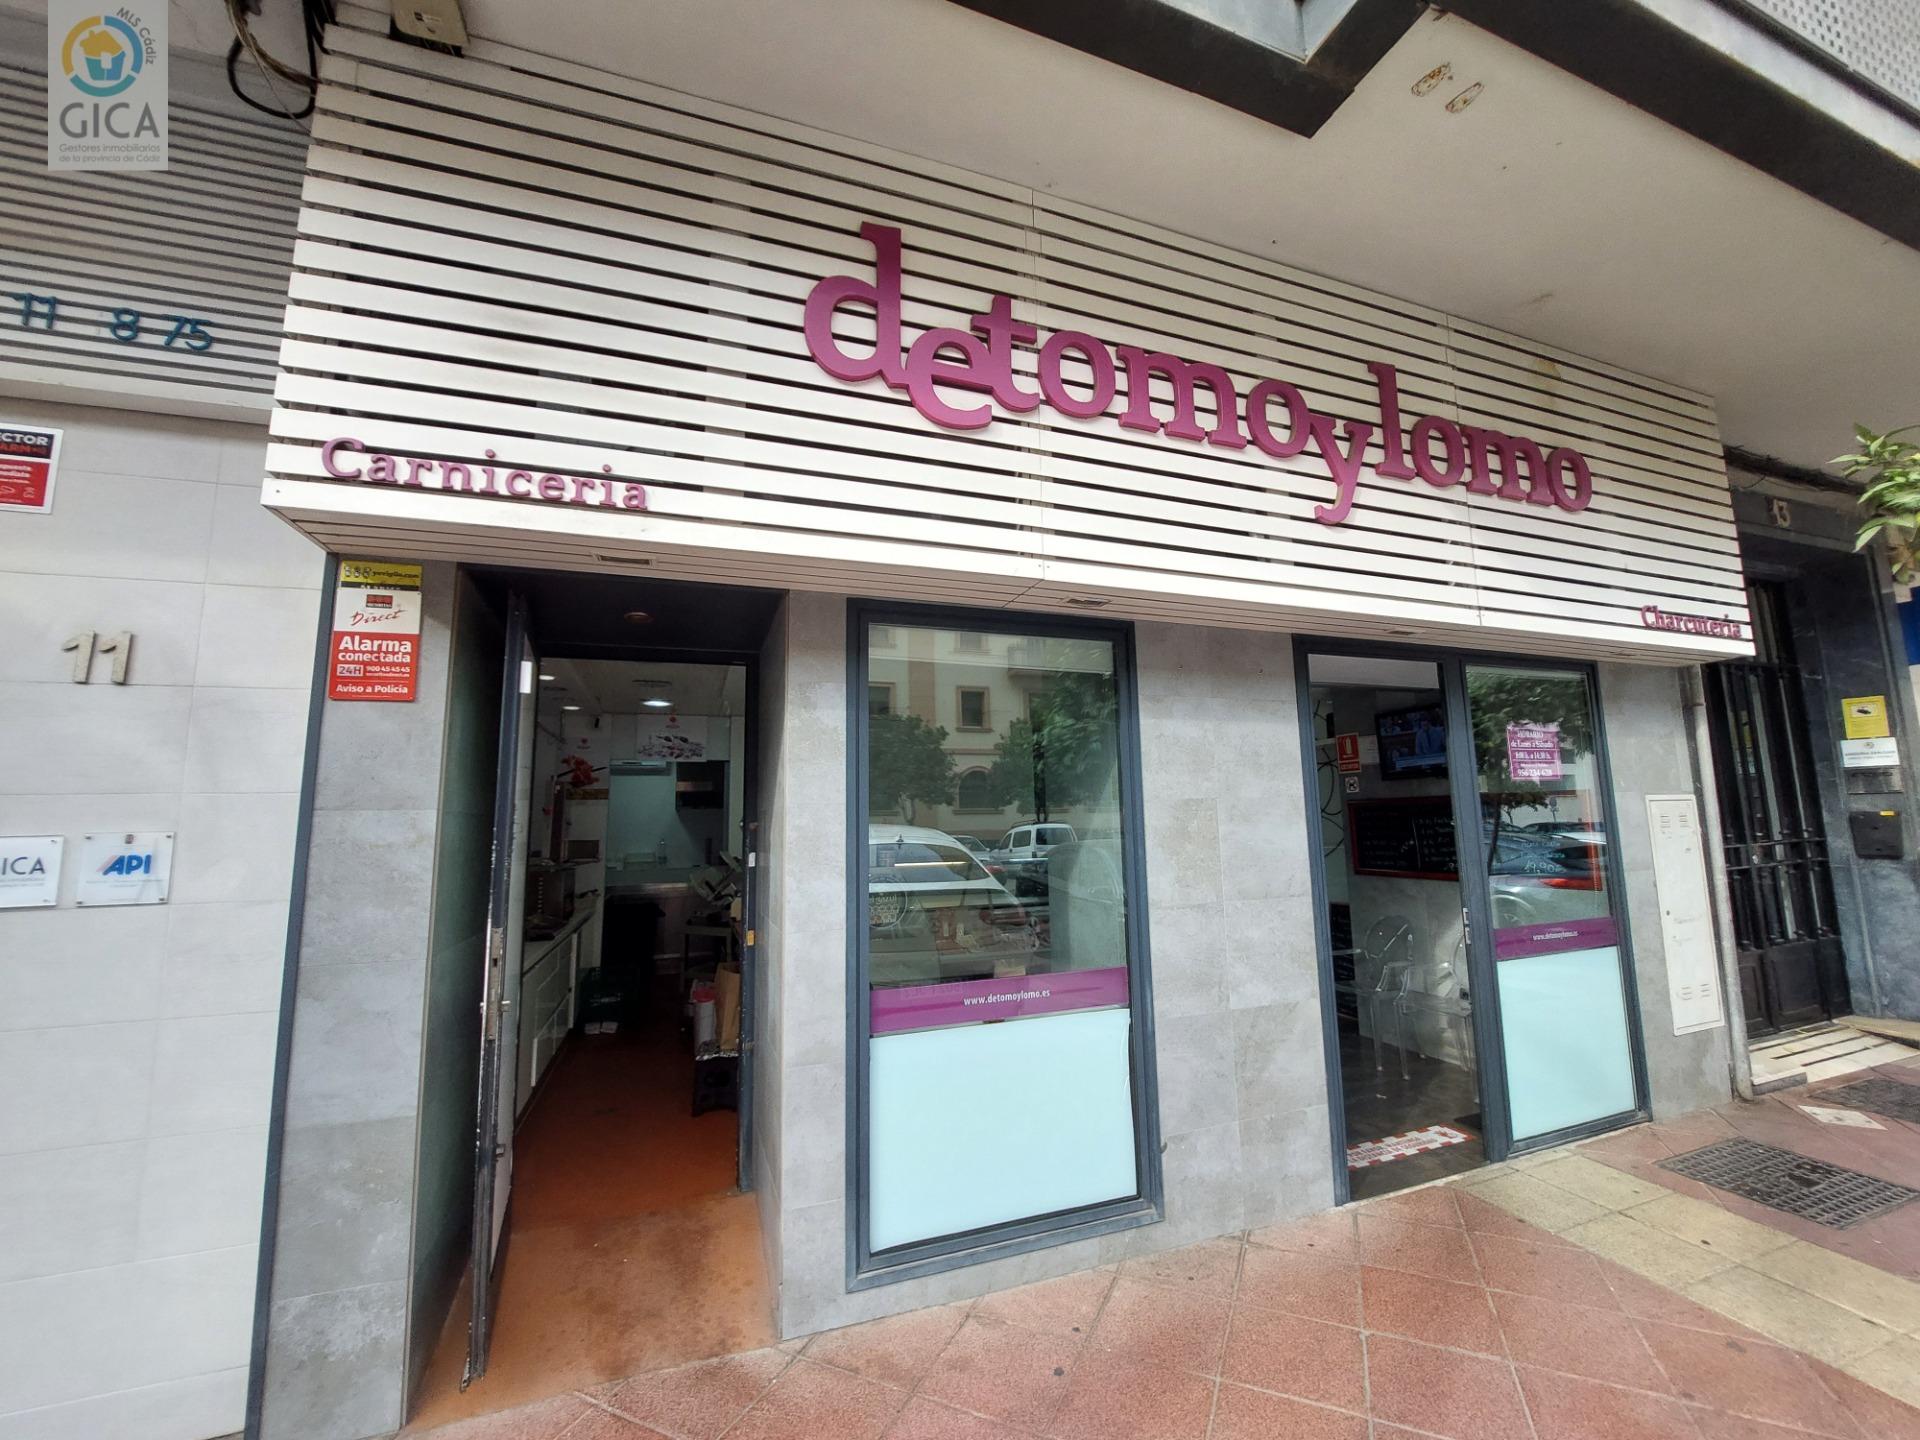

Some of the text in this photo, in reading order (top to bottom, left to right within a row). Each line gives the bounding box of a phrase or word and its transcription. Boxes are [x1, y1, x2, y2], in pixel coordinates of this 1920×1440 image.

[110, 307, 140, 343] 8
[803, 221, 1592, 526] detomoylomo
[322, 437, 649, 511] Carniceria
[1641, 605, 1742, 639] Charcuteria
[339, 635, 412, 653] Alarma
[62, 631, 134, 685] 11
[338, 652, 411, 663] conectada
[339, 666, 361, 675] 24H
[336, 684, 364, 693] Aviso
[0, 856, 46, 876] ICA
[102, 855, 152, 876] API
[963, 989, 1050, 1006] www.detomoylomo.es
